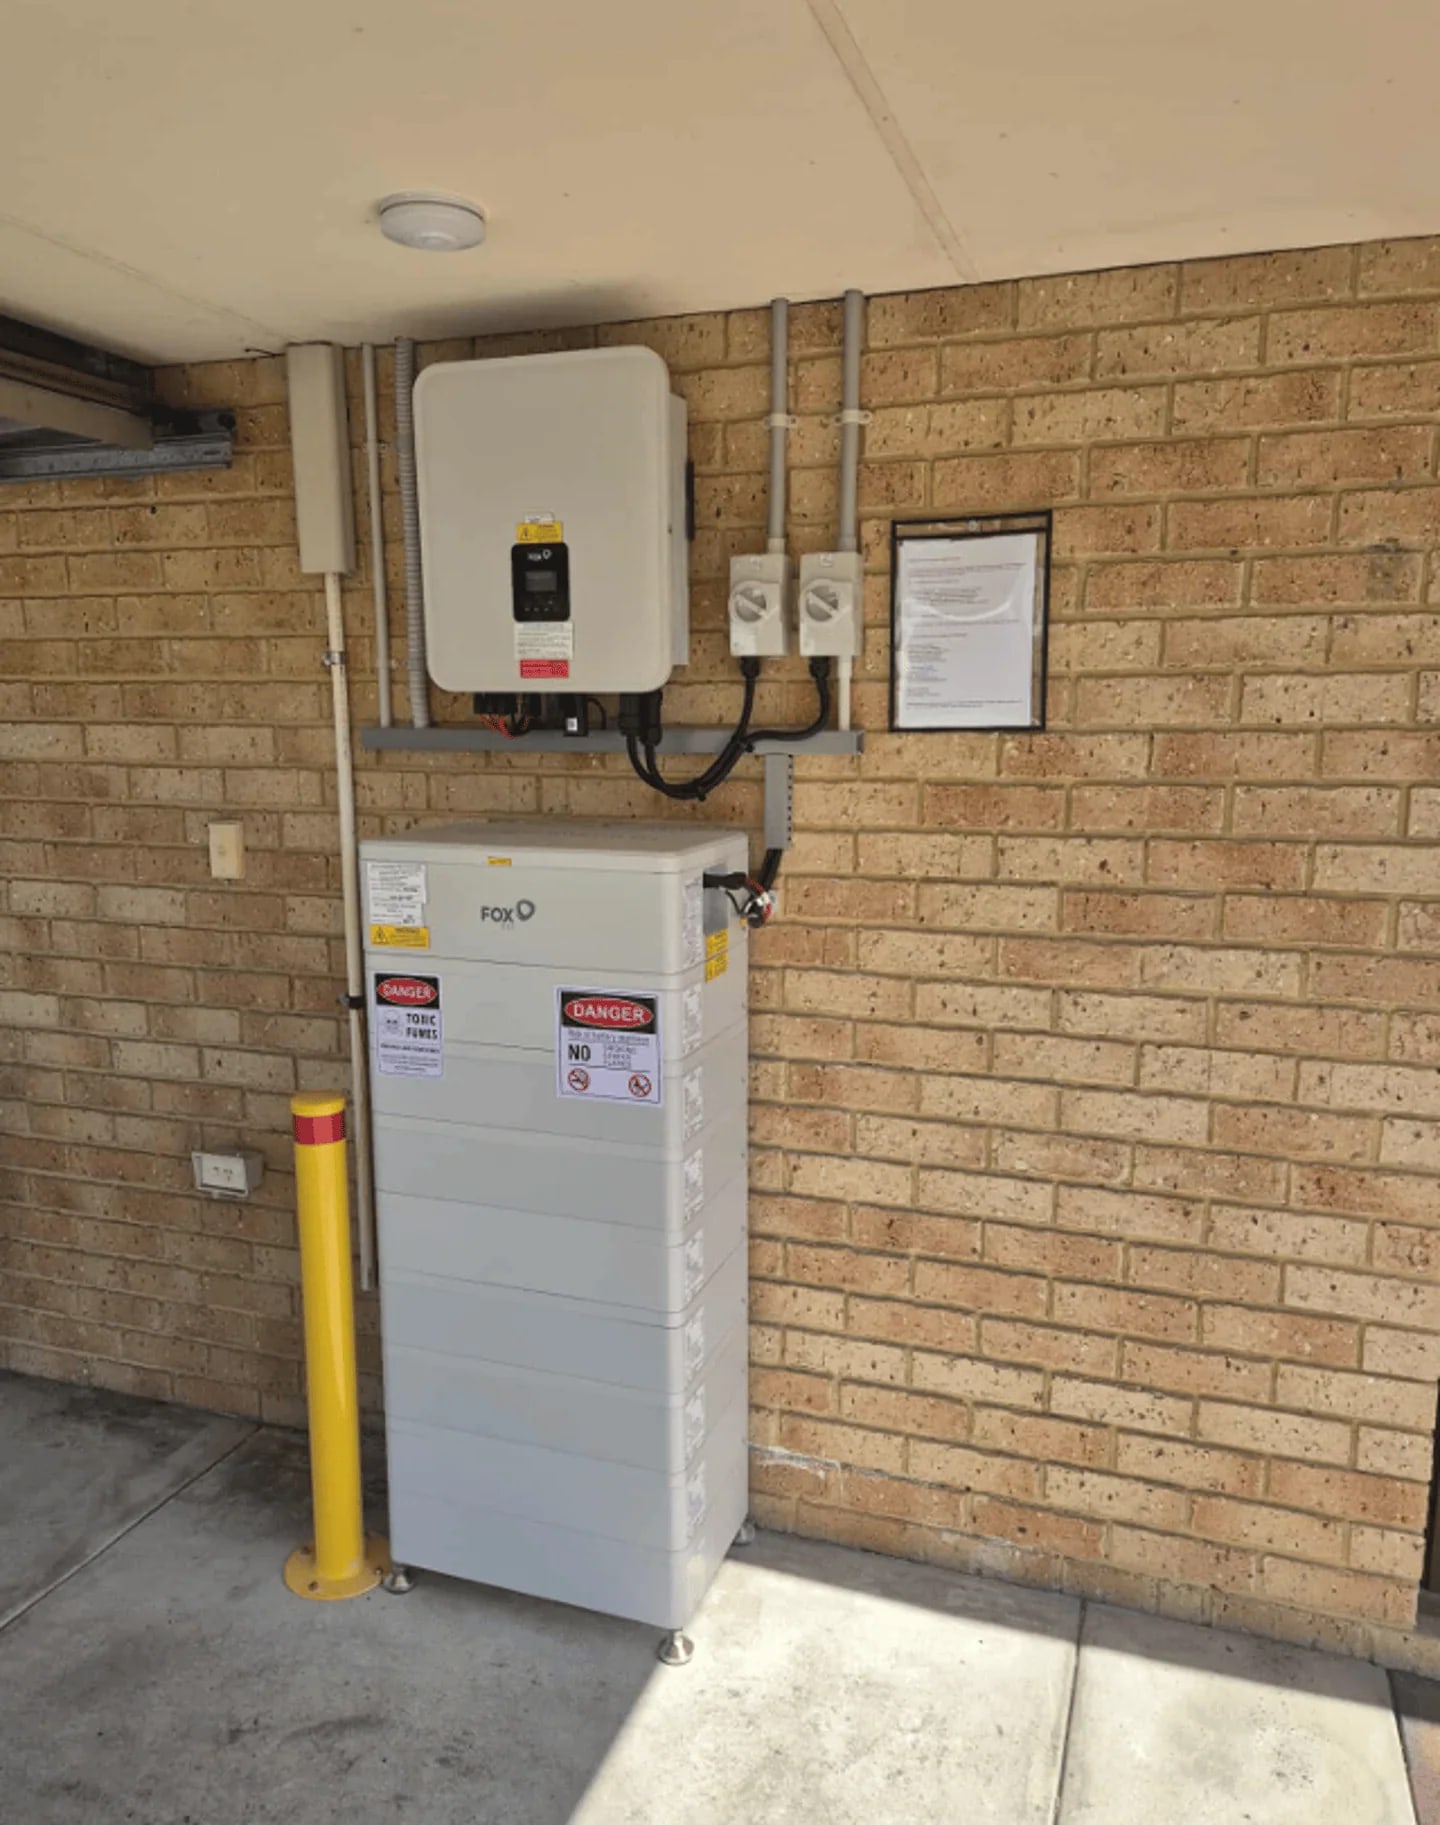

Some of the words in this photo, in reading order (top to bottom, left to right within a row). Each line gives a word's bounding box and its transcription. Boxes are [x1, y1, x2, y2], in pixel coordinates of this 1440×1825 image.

[481, 905, 514, 922] FOX
[383, 984, 431, 999] DANGER
[573, 1003, 645, 1024] DANGER
[568, 1043, 591, 1062] NO
